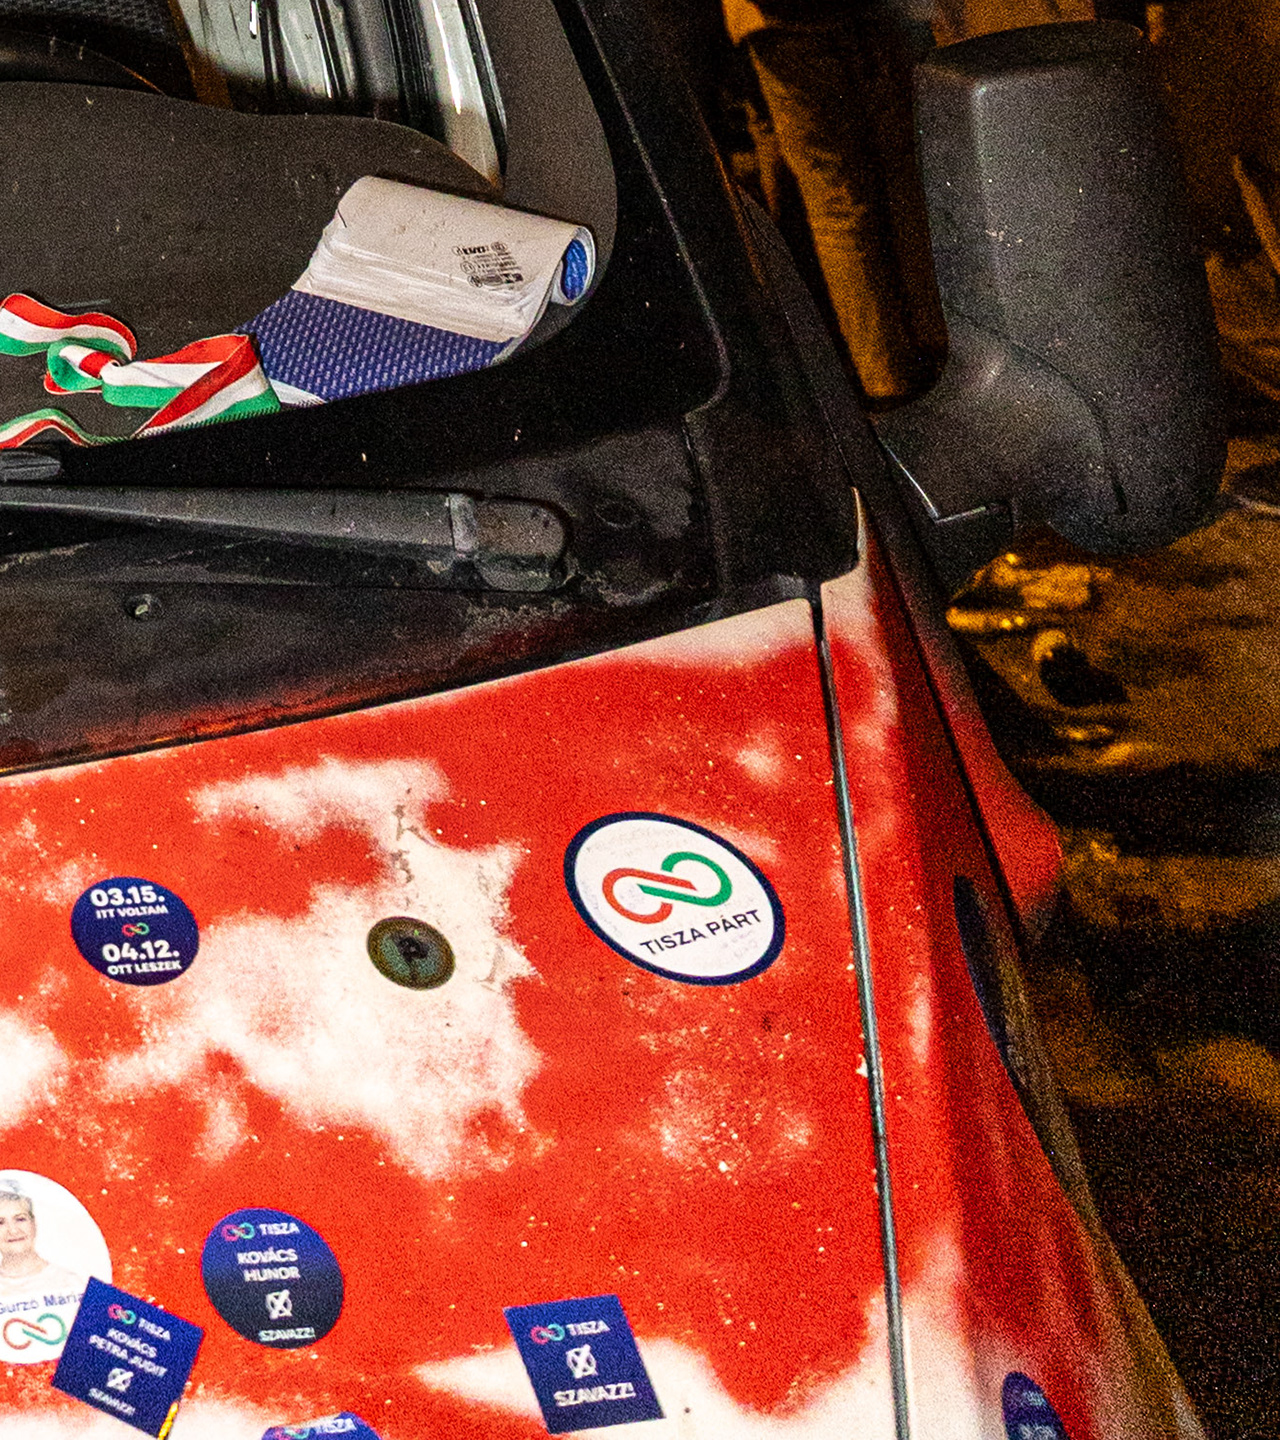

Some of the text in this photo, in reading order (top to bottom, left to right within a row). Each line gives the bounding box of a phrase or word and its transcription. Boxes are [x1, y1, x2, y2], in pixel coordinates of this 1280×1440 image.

[90, 885, 165, 907] 03.15.
[96, 904, 169, 919] ITT VOLTAM
[639, 909, 762, 955] TISZA PÁRT
[102, 939, 180, 963] 04.12.
[107, 960, 182, 975] OTT LESZEK
[259, 1222, 300, 1236] TISZA
[237, 1247, 298, 1265] KOVÁCS
[244, 1266, 300, 1282] HUNOR
[138, 1317, 172, 1341] TISZA
[258, 1327, 316, 1342] SZAVAZZ!
[566, 1320, 611, 1336] TISZA
[89, 1334, 129, 1360] PETRA
[106, 1328, 157, 1358] KOVÁCS
[553, 1382, 637, 1407] SZAVAZZ!
